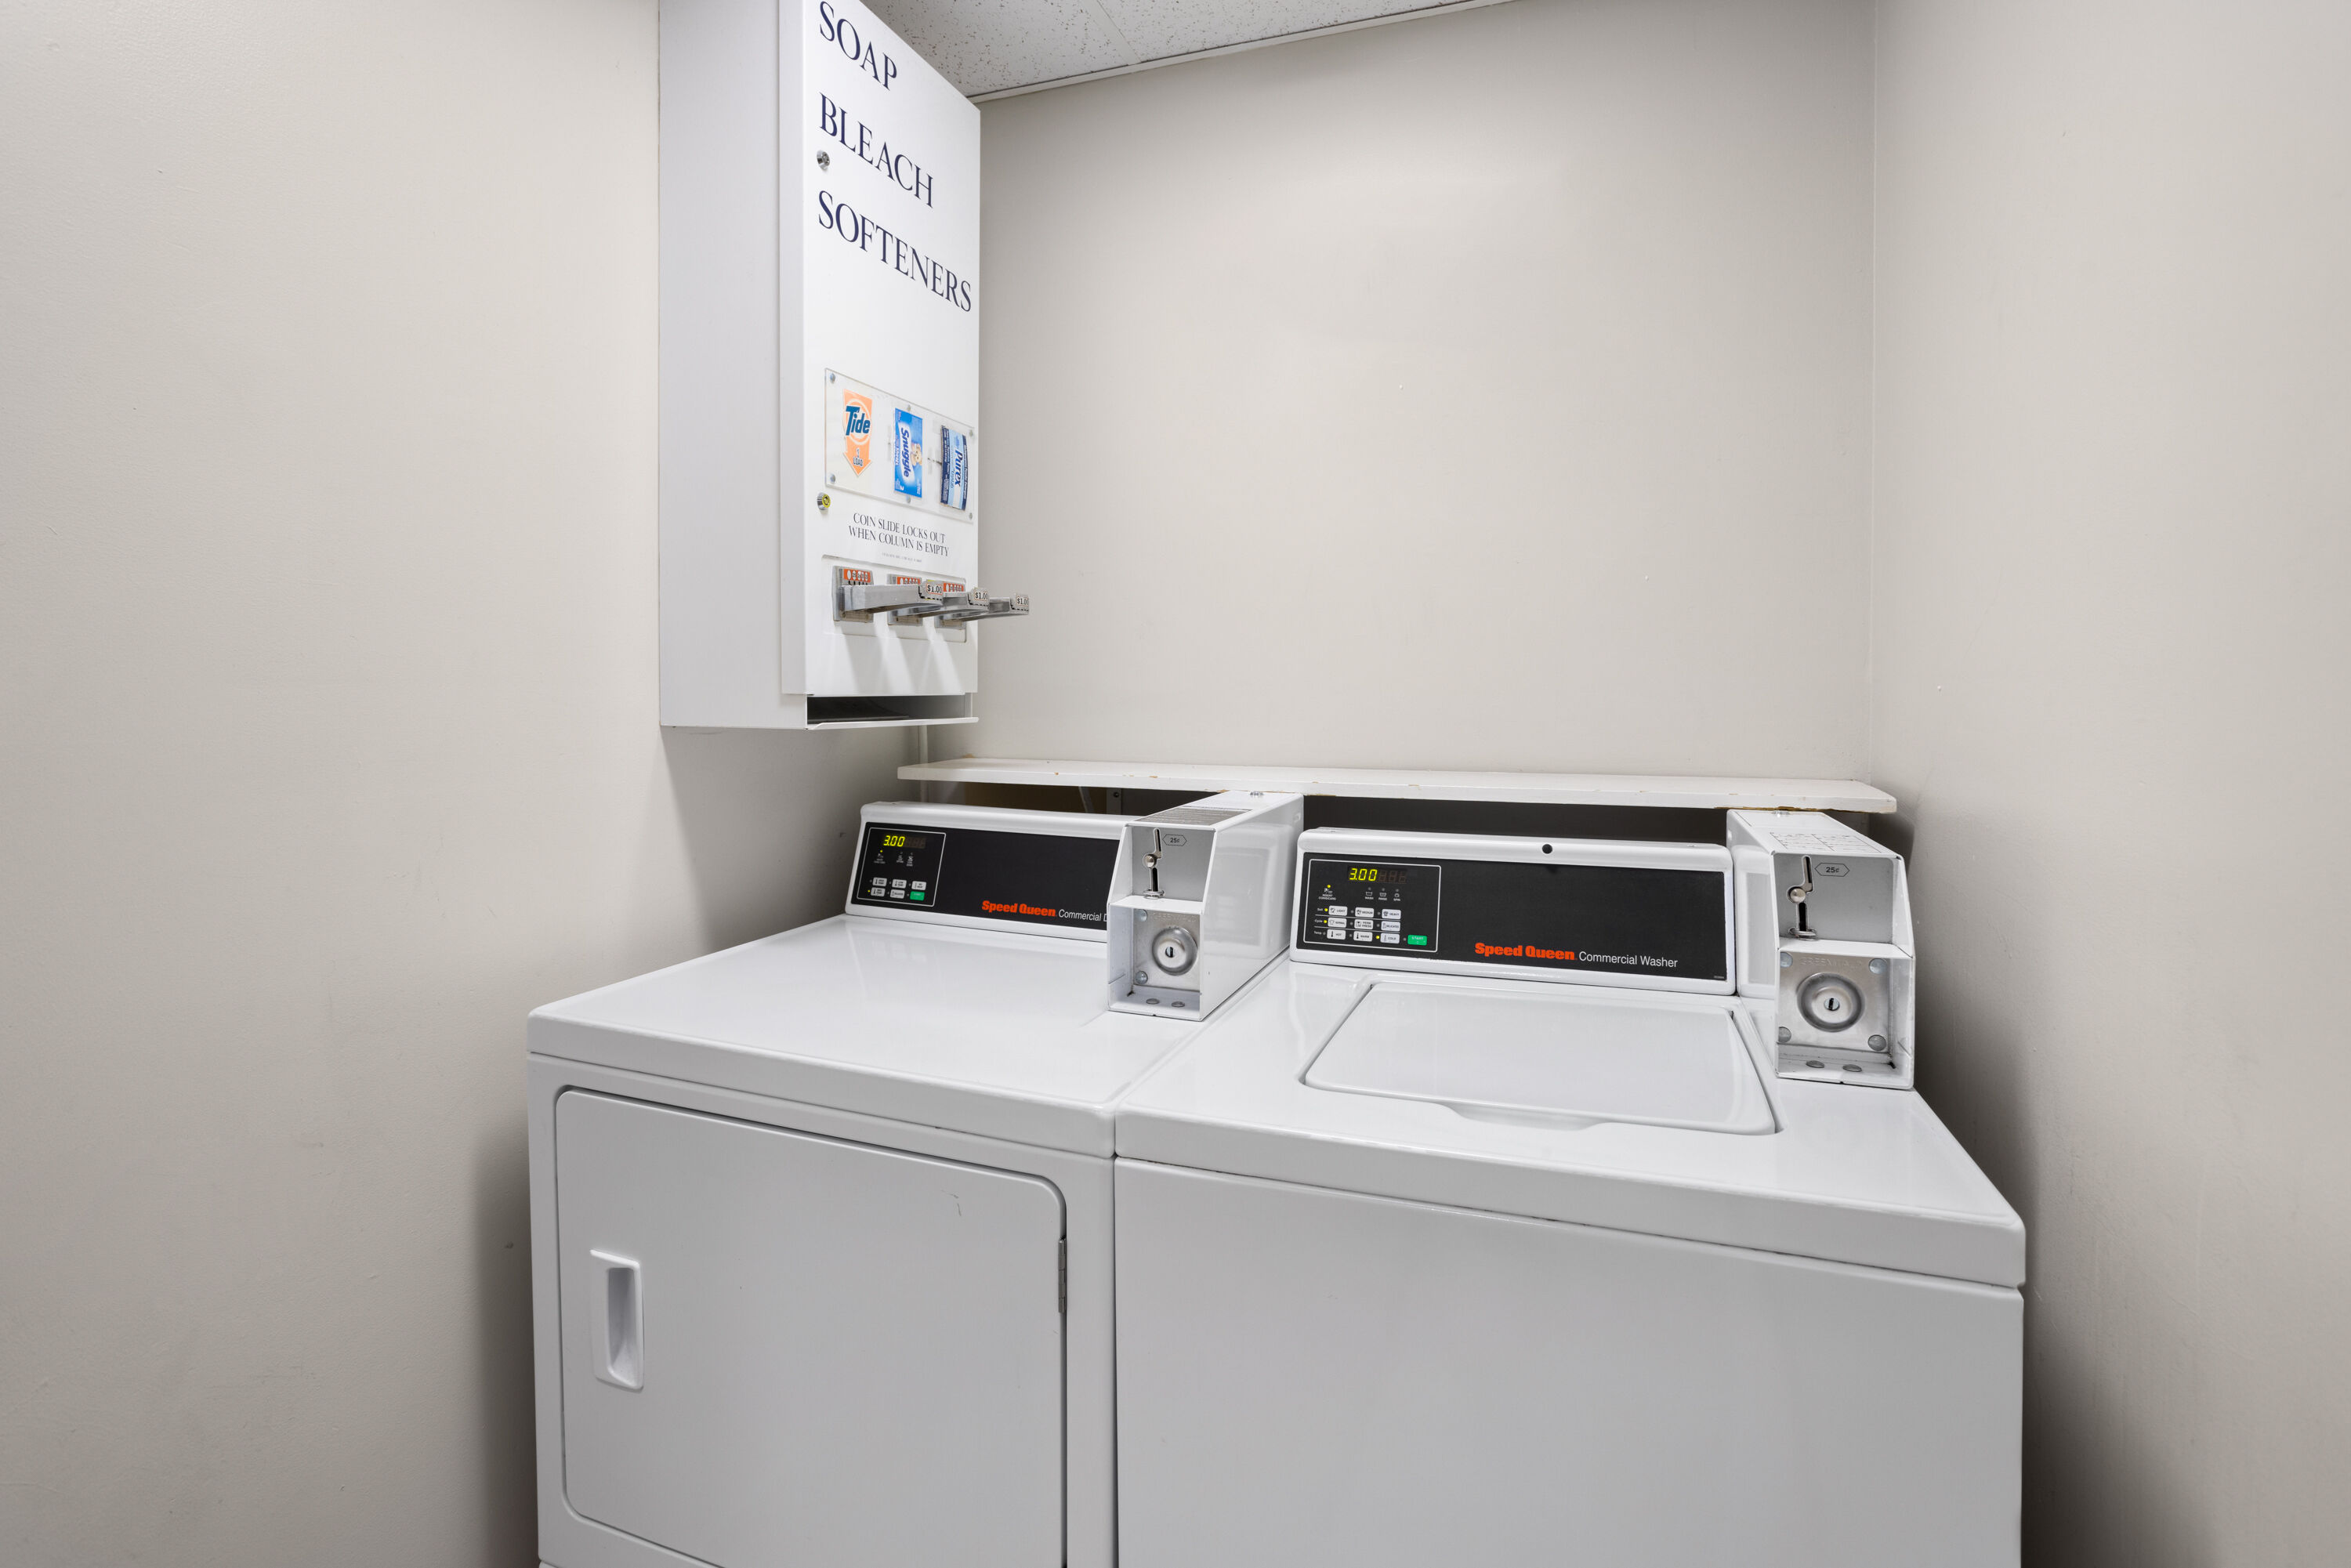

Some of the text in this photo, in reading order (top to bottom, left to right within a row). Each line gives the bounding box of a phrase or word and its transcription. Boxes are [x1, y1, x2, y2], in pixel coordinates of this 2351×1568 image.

[820, 1, 897, 91] SOAP
[819, 92, 933, 208] BLEACH
[818, 190, 972, 312] SOFTENERS
[846, 405, 871, 436] Tide
[900, 427, 911, 478] Snuggle
[955, 449, 963, 487] Purex
[849, 525, 949, 556] WHEN COLUMN IS EMPTY
[853, 512, 946, 543] COIN SLIDE LOCKS OUT
[883, 835, 905, 847] 3.00
[1349, 867, 1378, 882] 3.00
[981, 900, 1018, 914] Speed
[1020, 904, 1056, 917] Queen
[1059, 909, 1101, 922] Commercial
[1474, 942, 1679, 968] Speed Queen Commercial Washer
